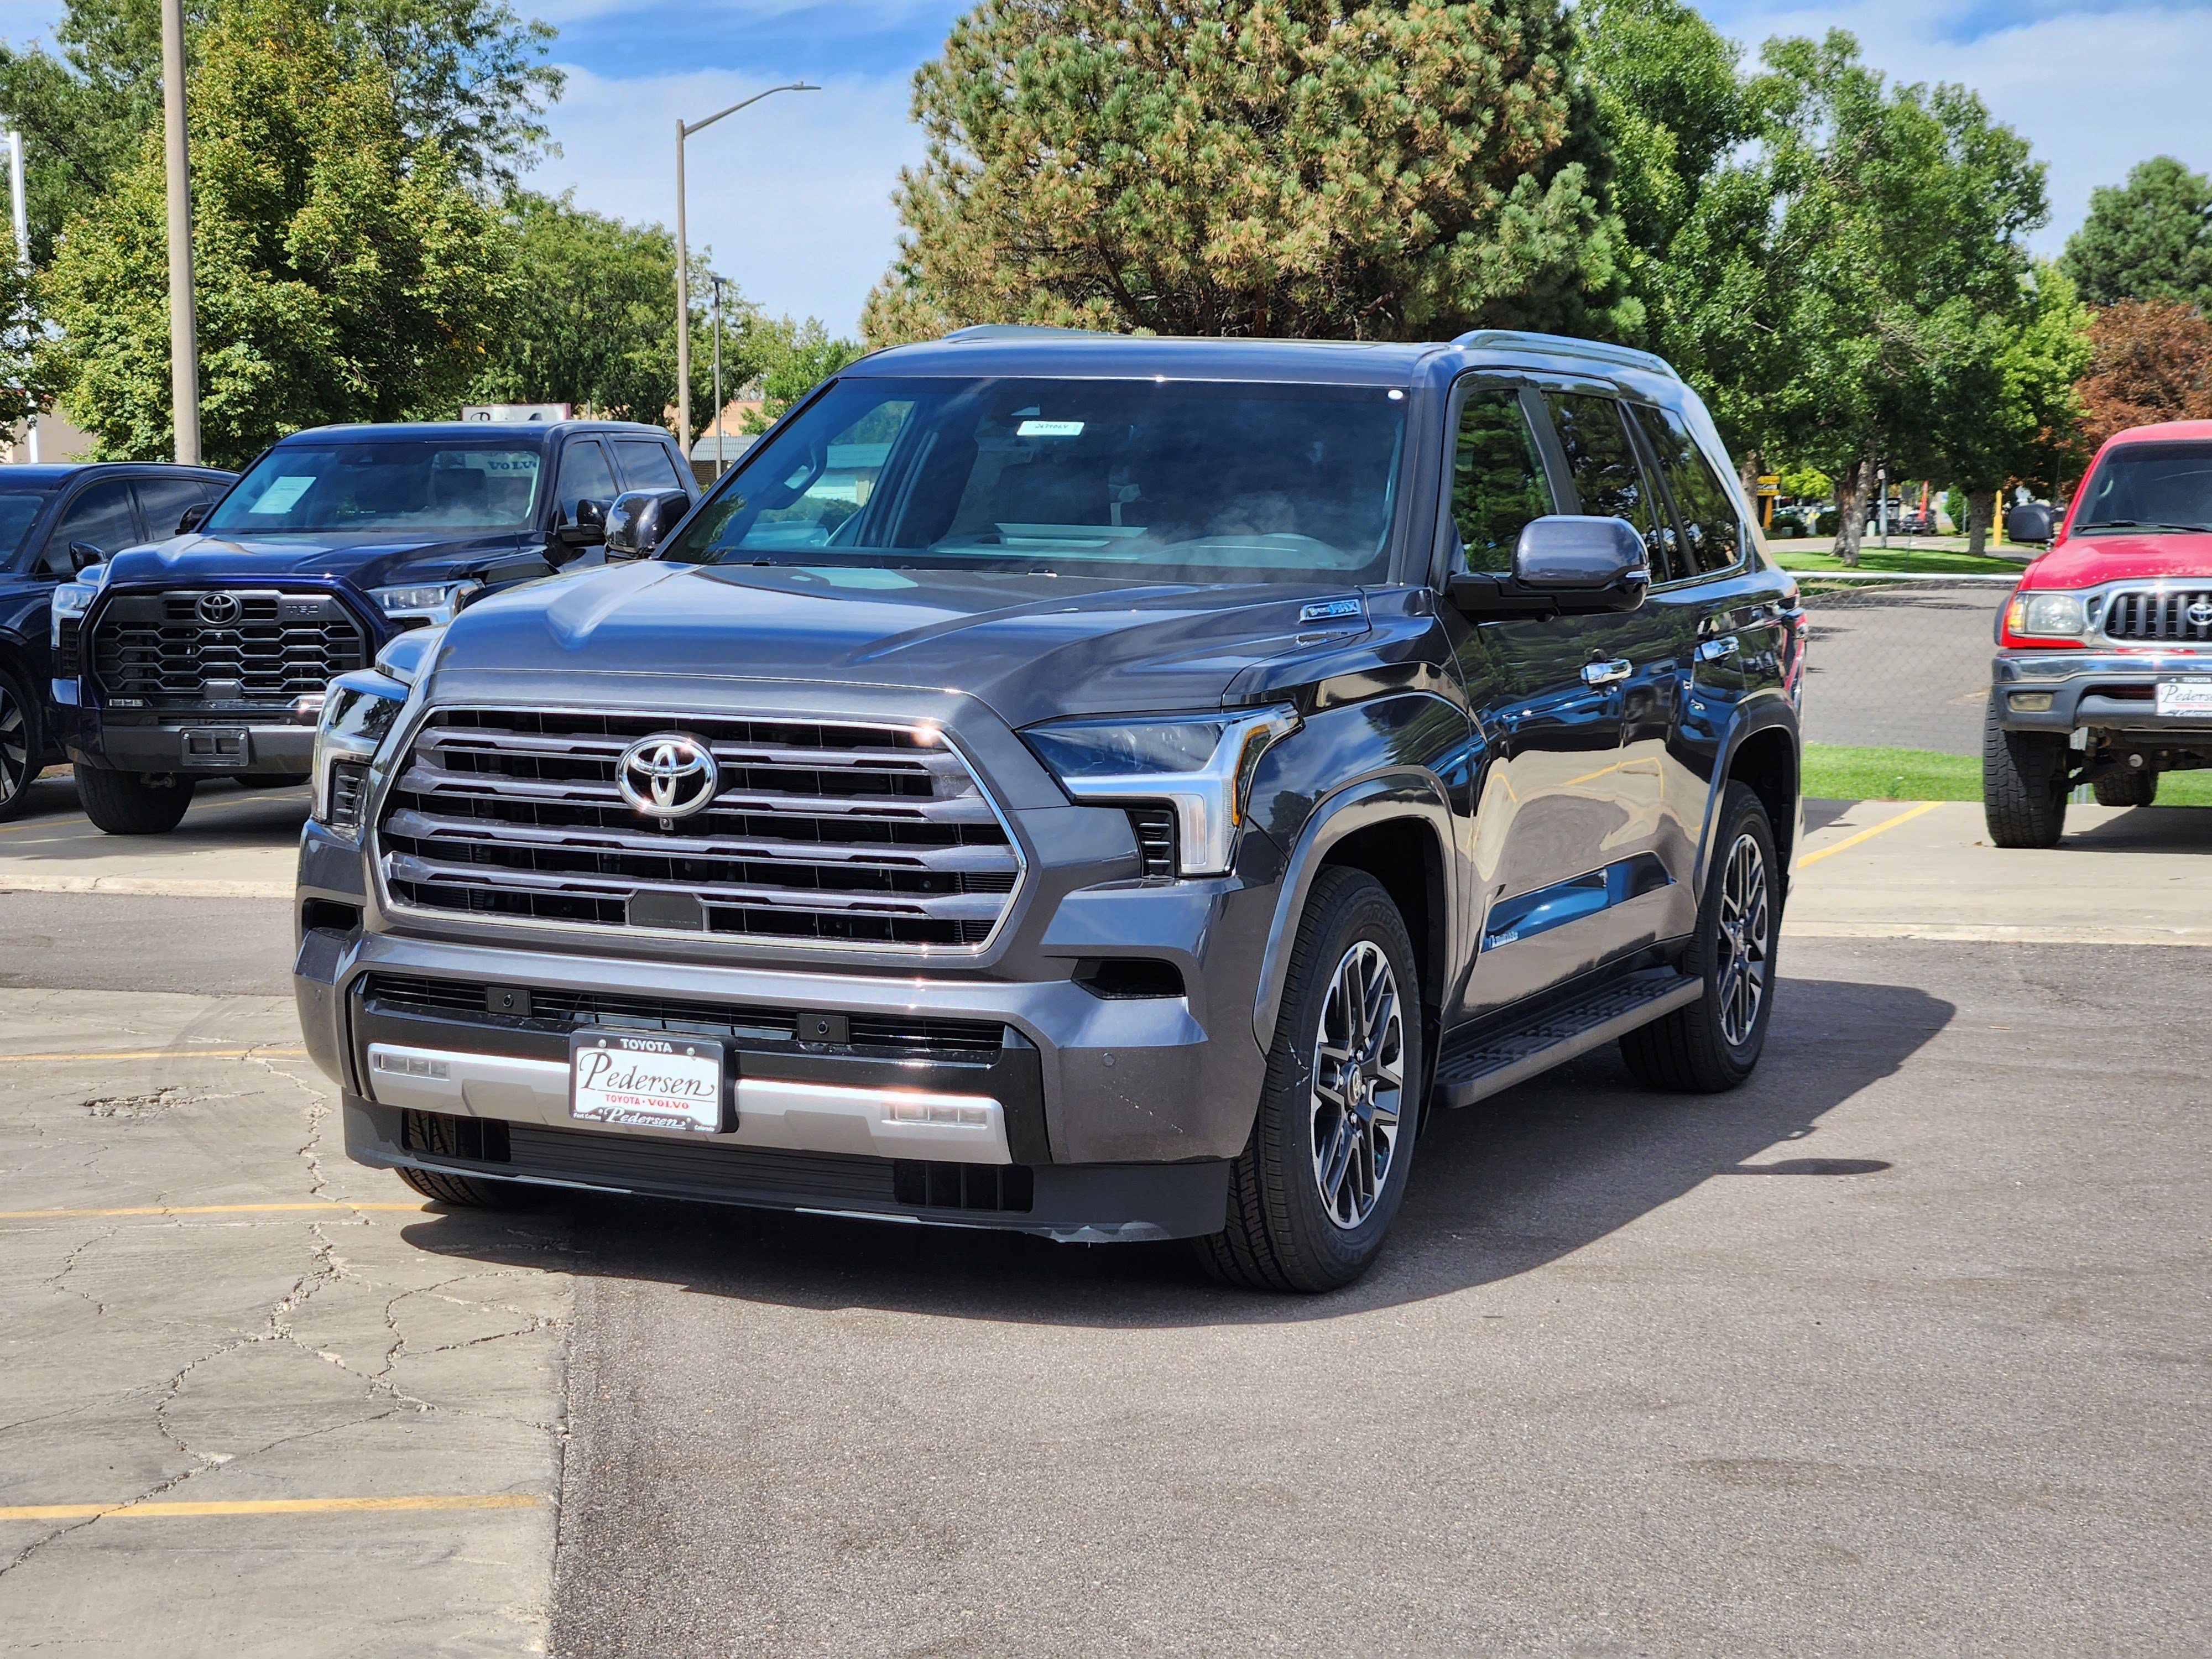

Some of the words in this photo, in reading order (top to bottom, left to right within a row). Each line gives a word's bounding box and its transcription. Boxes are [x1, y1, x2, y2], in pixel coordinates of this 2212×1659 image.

[619, 1039, 673, 1053] TOYOTA
[579, 1052, 715, 1096] Pedersen
[606, 1094, 640, 1105] TOYOTA
[648, 1098, 689, 1109] VOLVO
[604, 1106, 686, 1127] Pedersen
